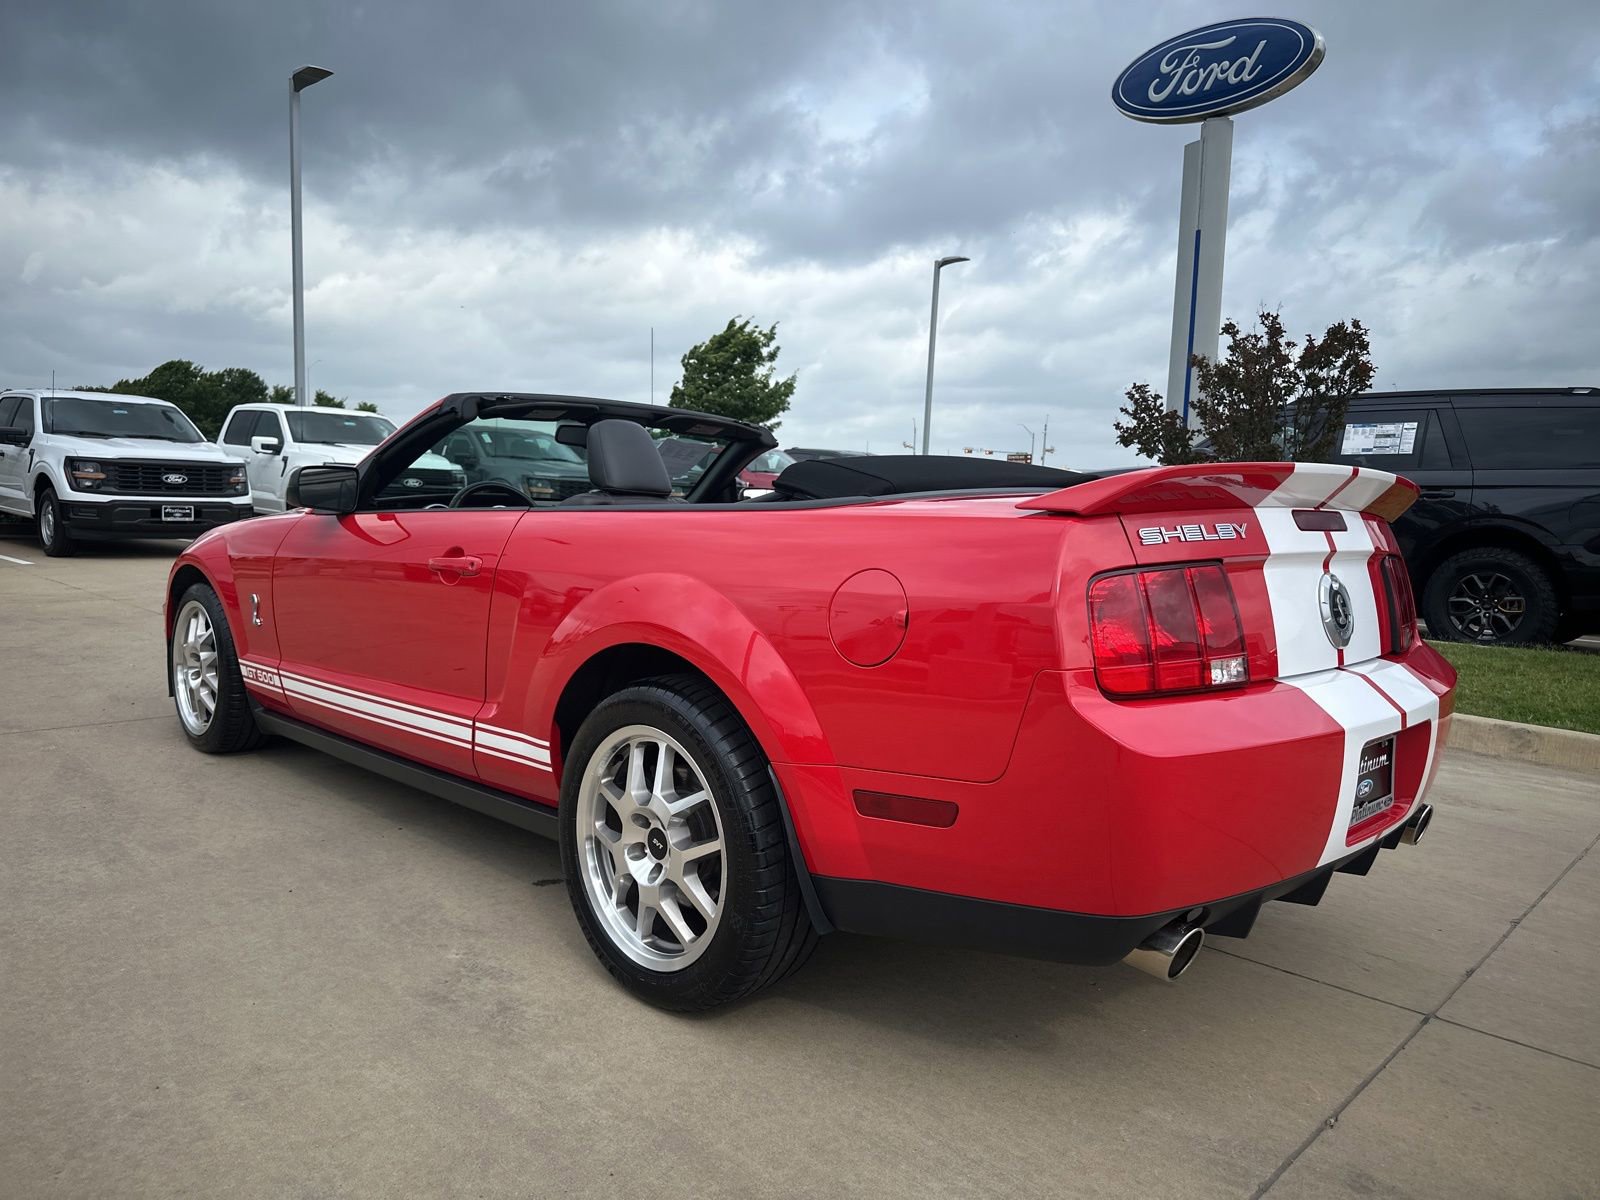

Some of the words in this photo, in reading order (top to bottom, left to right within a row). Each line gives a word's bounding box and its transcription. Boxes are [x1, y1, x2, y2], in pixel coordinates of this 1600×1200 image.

[1148, 35, 1267, 102] Ford
[1138, 523, 1248, 545] SHELBY
[247, 667, 257, 679] GT
[257, 670, 275, 685] 500
[1358, 754, 1390, 776] tinum
